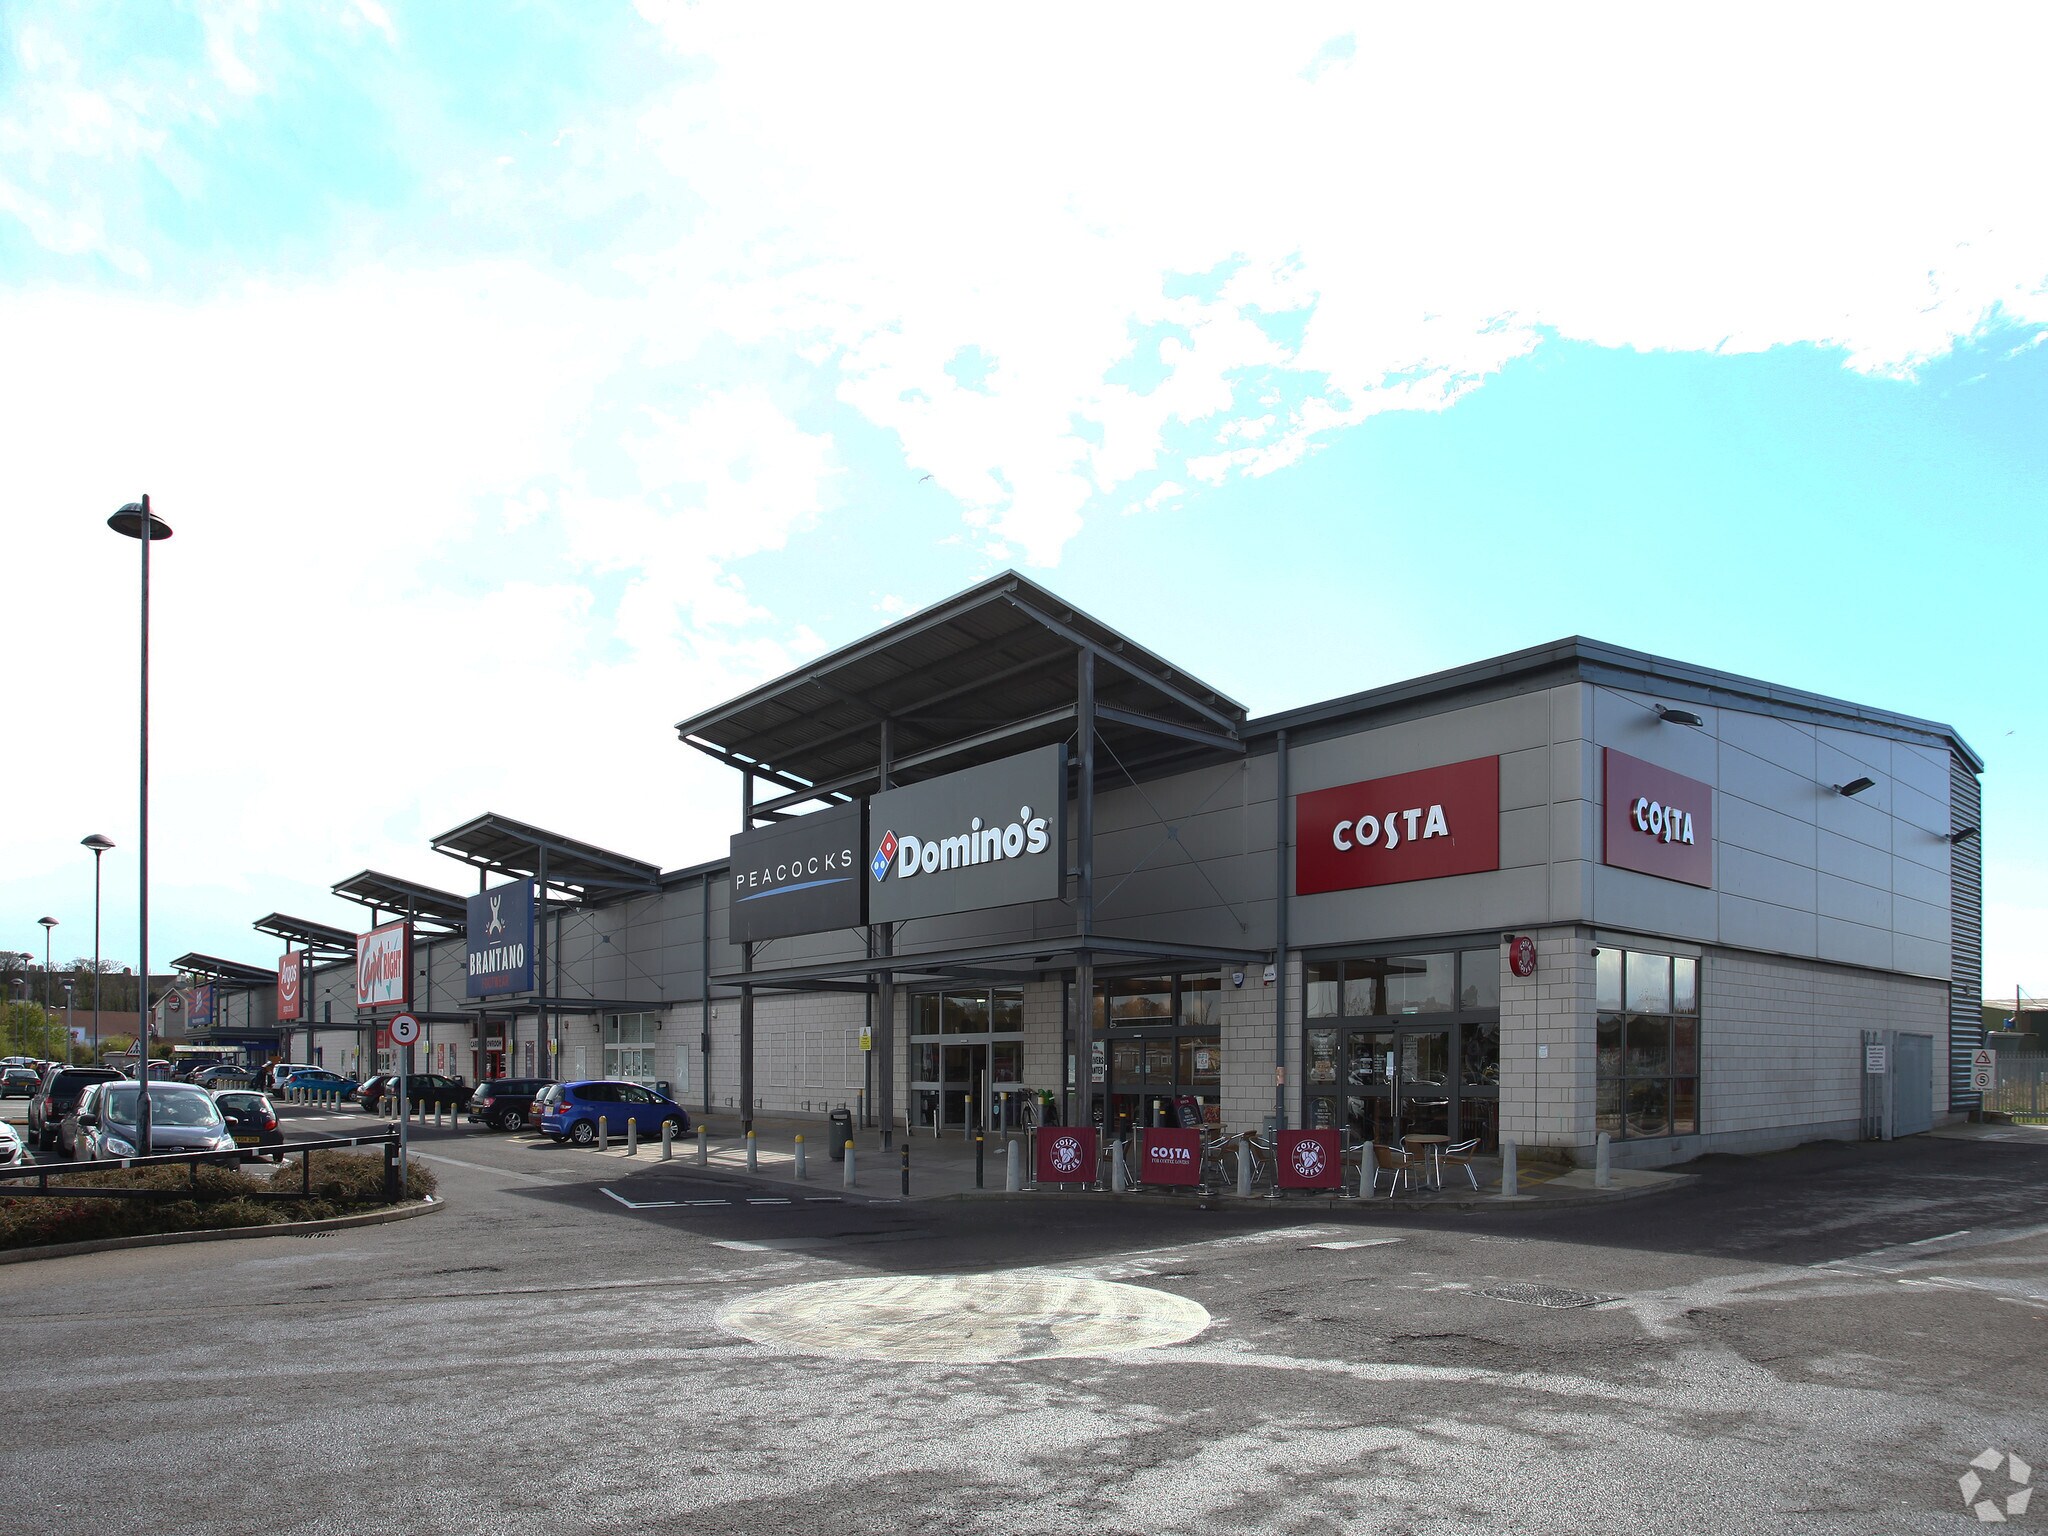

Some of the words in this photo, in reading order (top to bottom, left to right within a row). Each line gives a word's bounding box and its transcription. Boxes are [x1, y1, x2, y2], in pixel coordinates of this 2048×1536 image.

[1333, 804, 1449, 851] COSTA
[1635, 797, 1695, 845] COSTA
[898, 805, 1050, 878] Domino's
[736, 849, 852, 890] PEACOCKS
[469, 943, 524, 976] BRANTANO
[281, 961, 297, 990] Argos
[400, 1023, 410, 1036] 5
[1979, 1075, 1986, 1084] 5
[1055, 1139, 1077, 1149] COSTA
[1296, 1142, 1320, 1152] COSTA
[1151, 1146, 1191, 1160] COSTA
[1053, 1158, 1080, 1171] COFFEE
[1295, 1162, 1323, 1175] COFFEE
